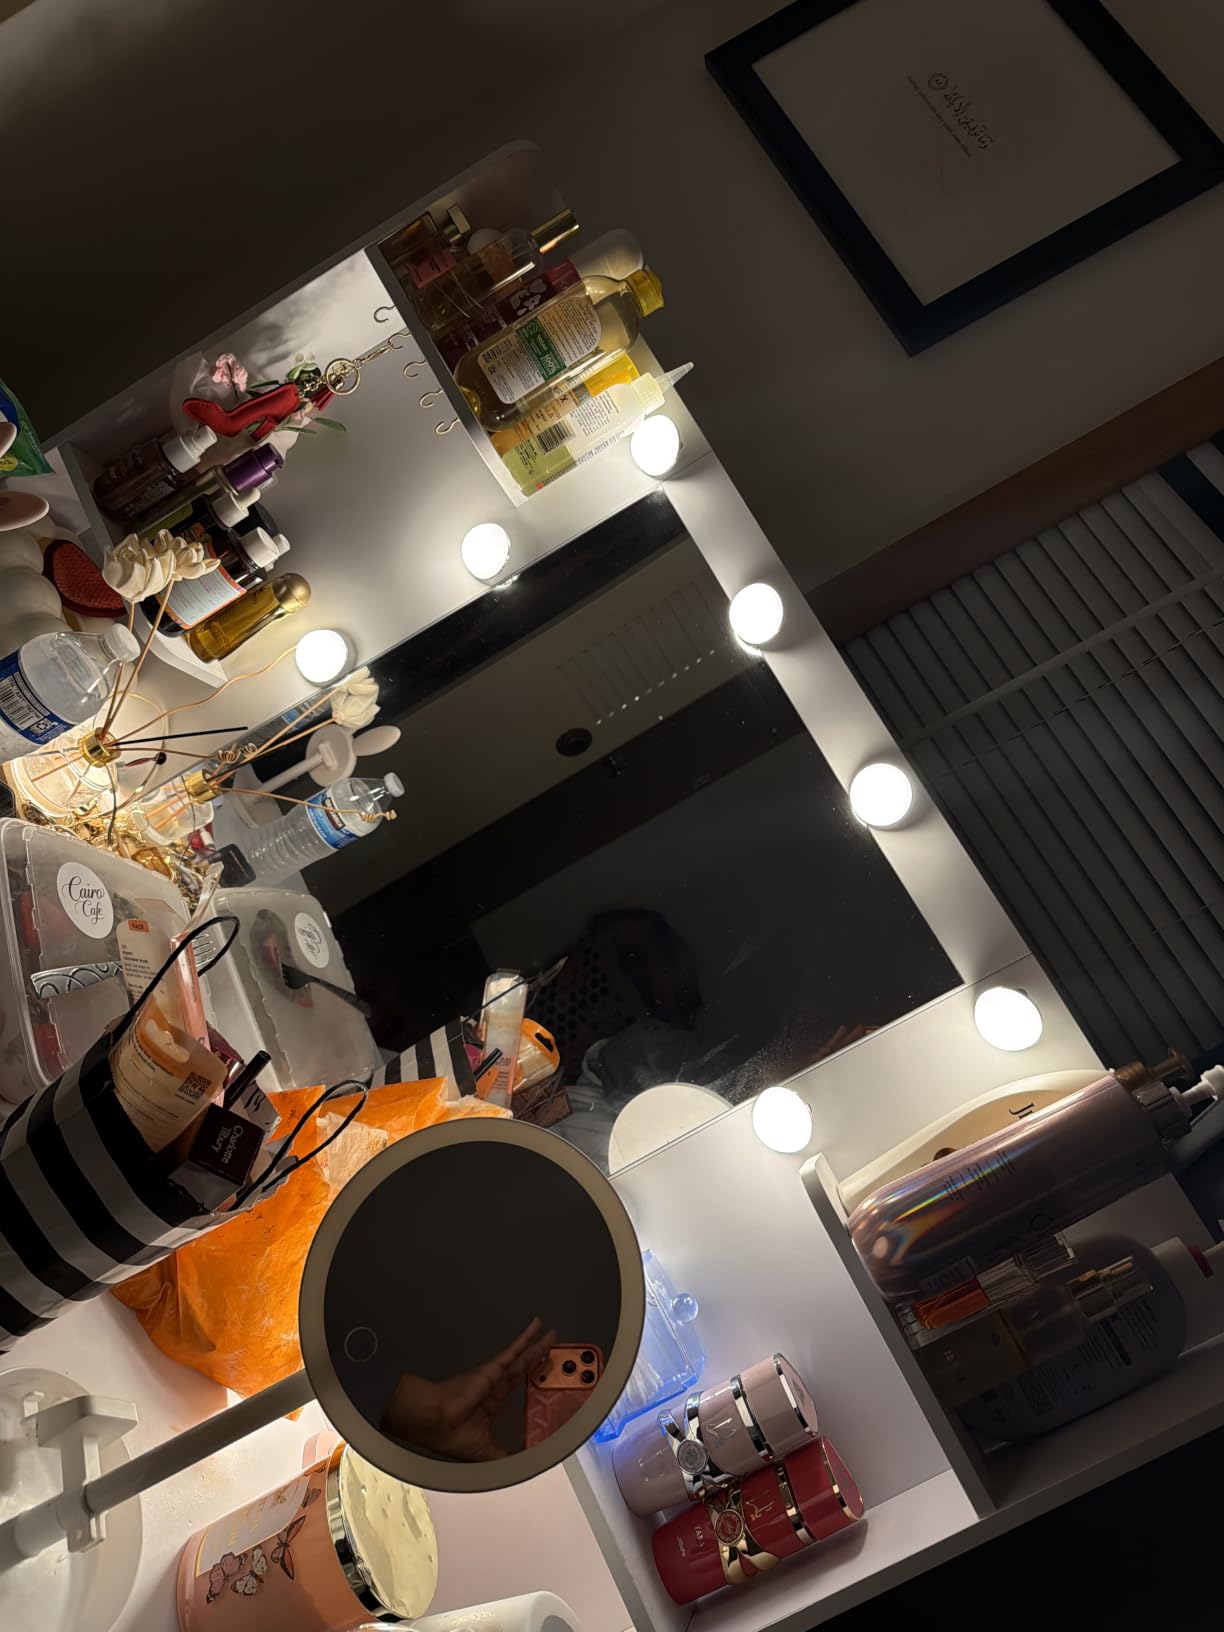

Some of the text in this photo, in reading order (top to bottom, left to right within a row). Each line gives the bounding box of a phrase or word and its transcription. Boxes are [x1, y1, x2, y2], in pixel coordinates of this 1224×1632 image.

[542, 353, 557, 373] 100%
[62, 874, 105, 901] Cairo
[211, 1126, 231, 1152] Tilbury
[222, 1124, 243, 1164] Charlotte
